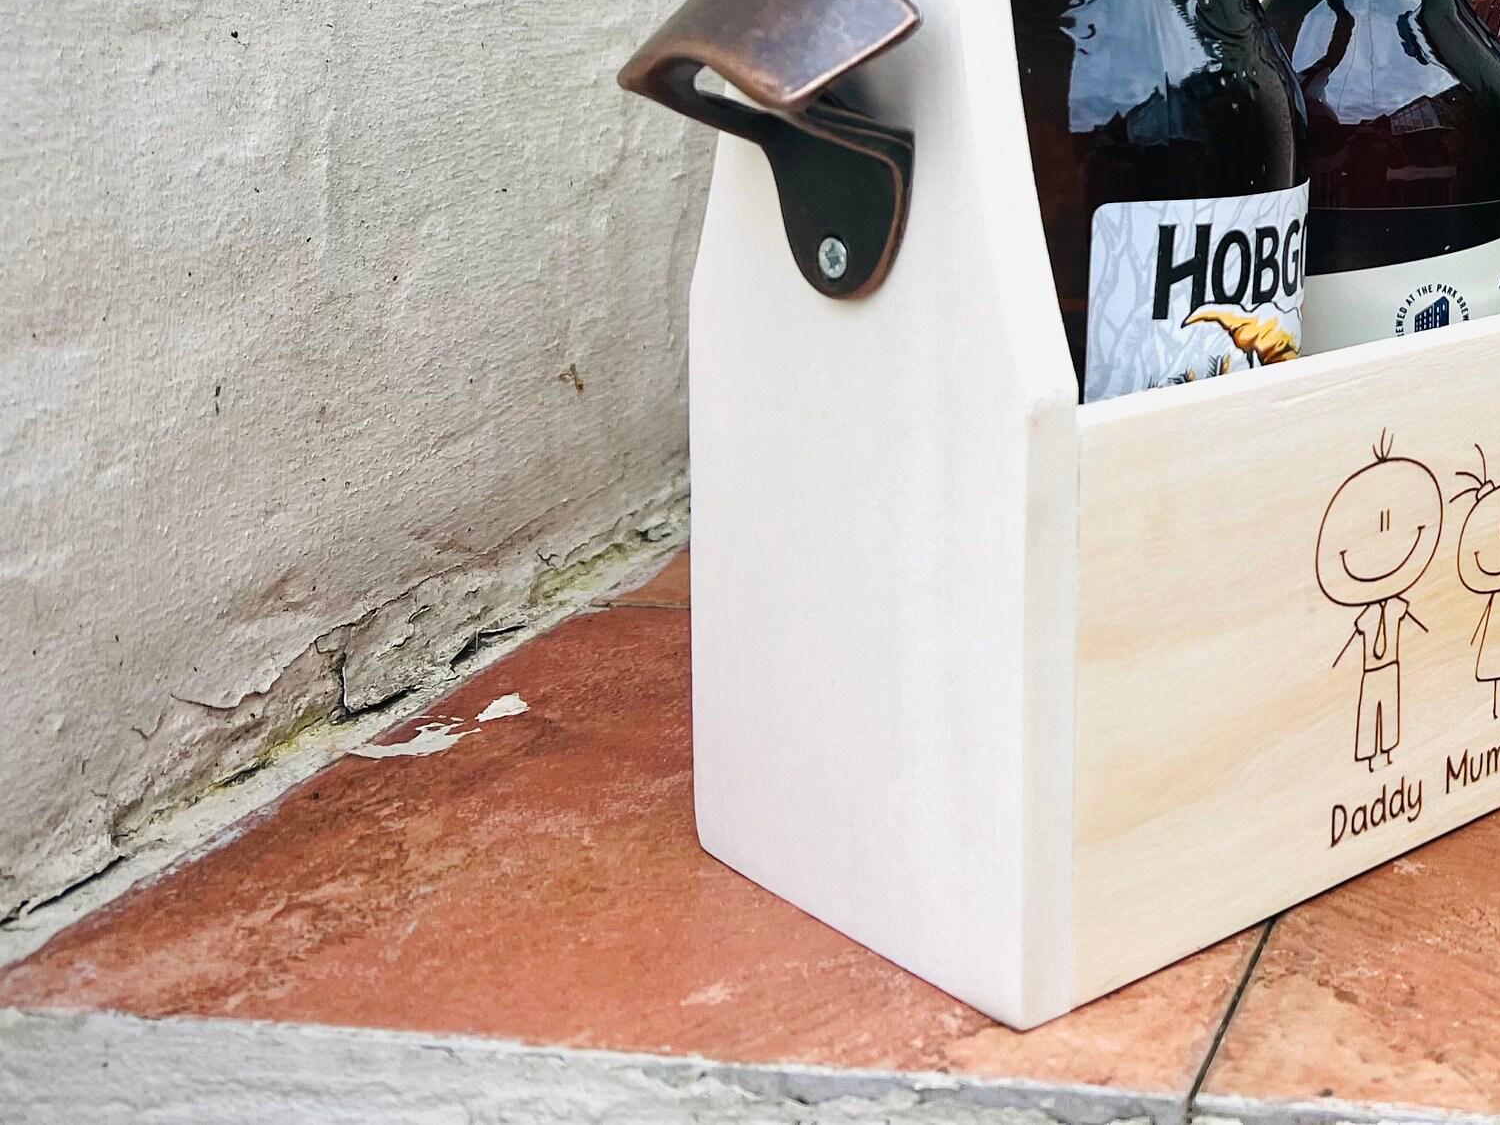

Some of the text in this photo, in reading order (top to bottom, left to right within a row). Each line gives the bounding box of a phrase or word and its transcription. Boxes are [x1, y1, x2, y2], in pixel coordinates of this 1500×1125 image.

[1151, 213, 1308, 322] HOBG
[1405, 293, 1416, 307] AT
[1416, 284, 1433, 297] THE
[1436, 283, 1458, 299] PARK
[1330, 775, 1423, 849] Daddy
